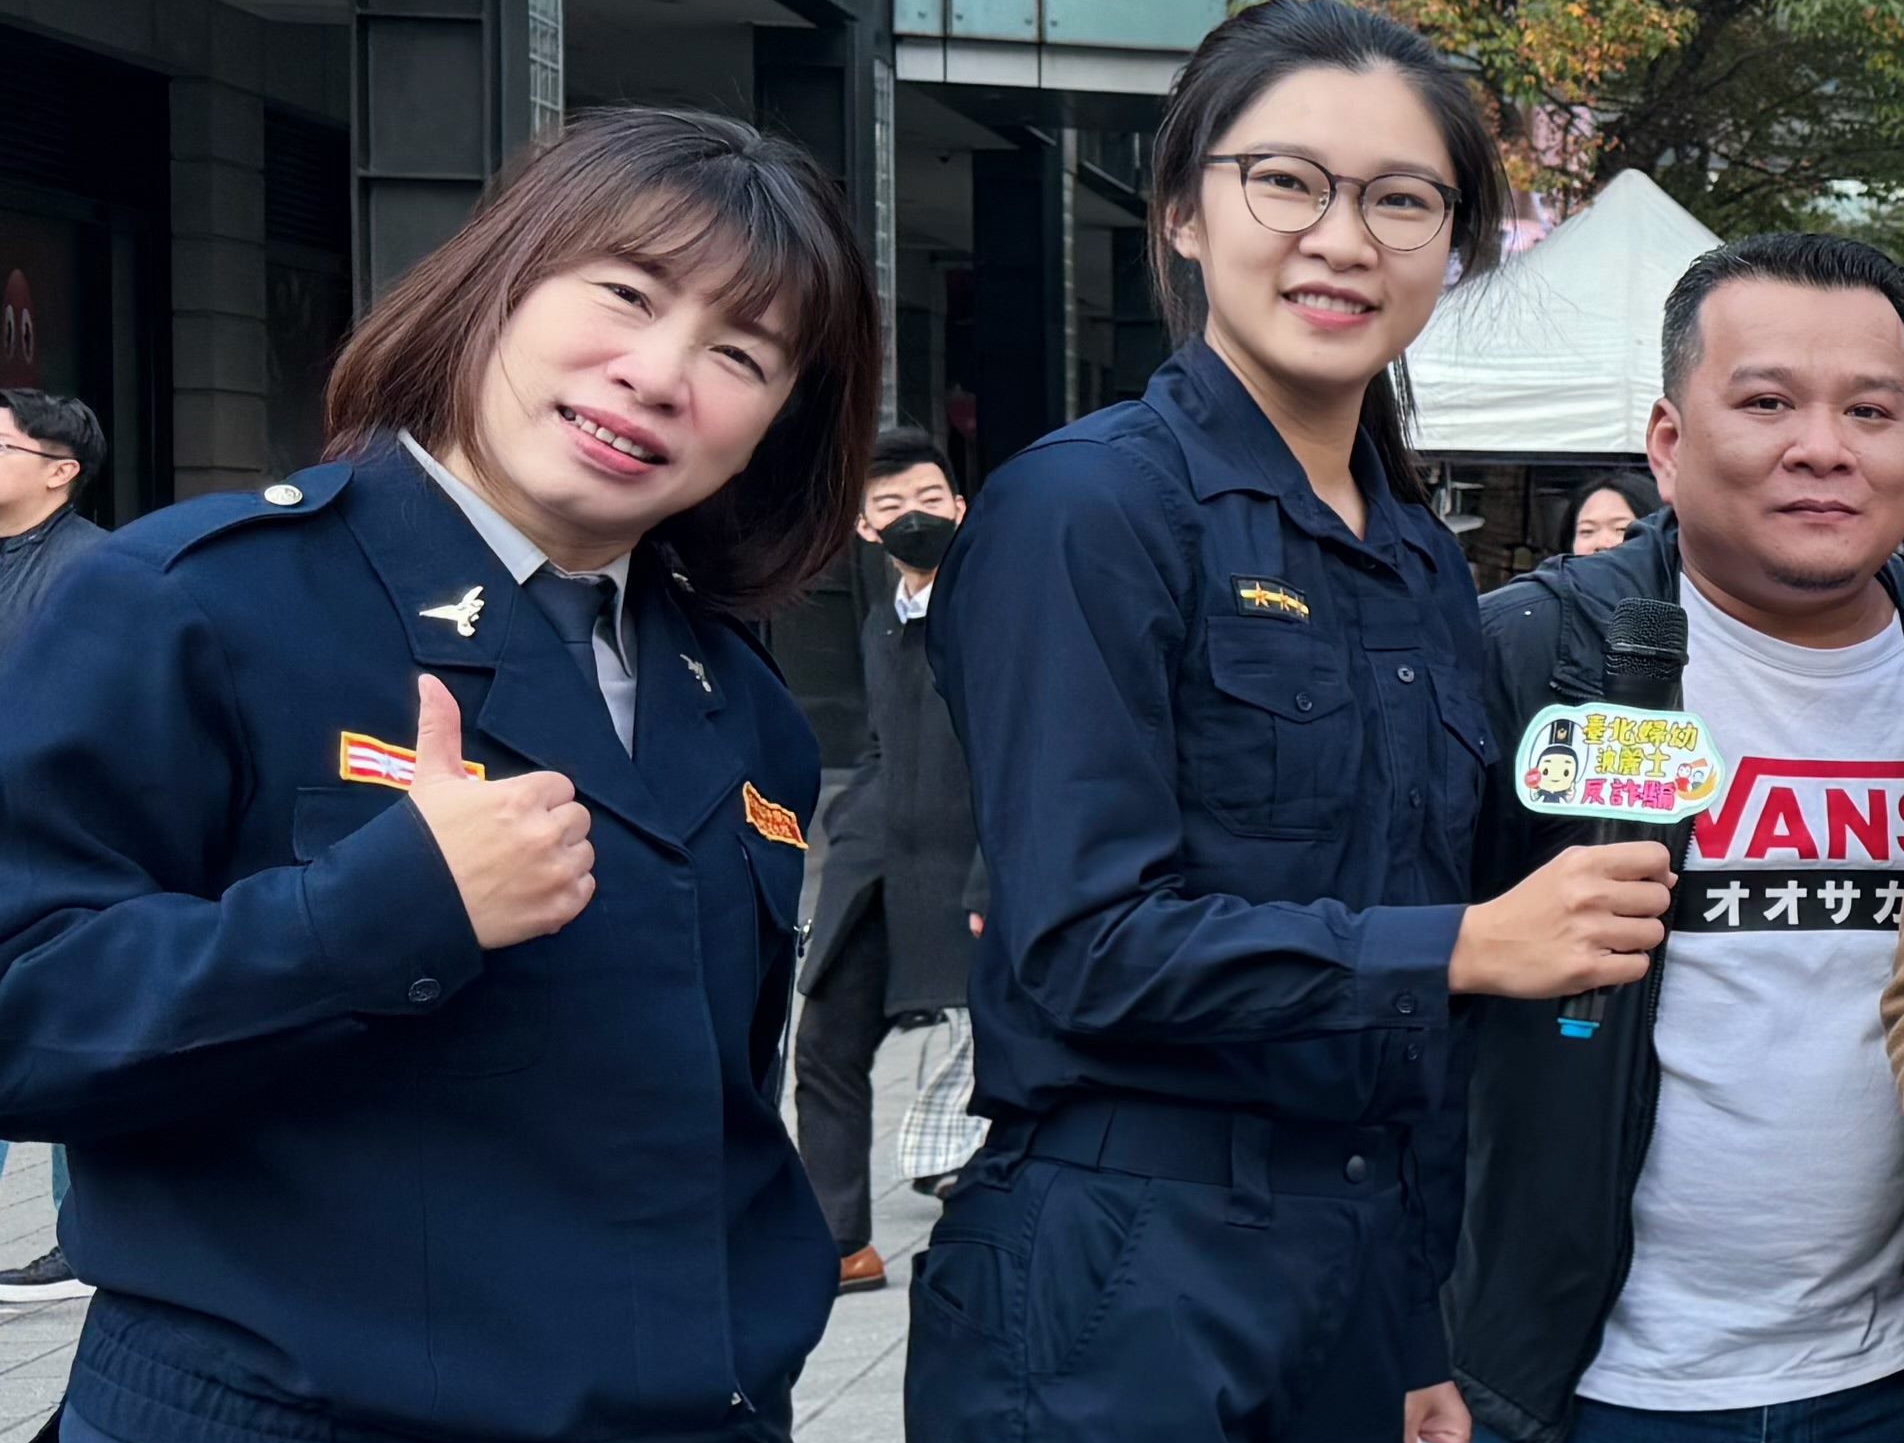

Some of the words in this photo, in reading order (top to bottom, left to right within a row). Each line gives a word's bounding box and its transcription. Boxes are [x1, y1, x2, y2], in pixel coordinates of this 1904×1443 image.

[1582, 713, 1699, 752] 臺北婦幼
[1580, 777, 1677, 811] 反詐騙
